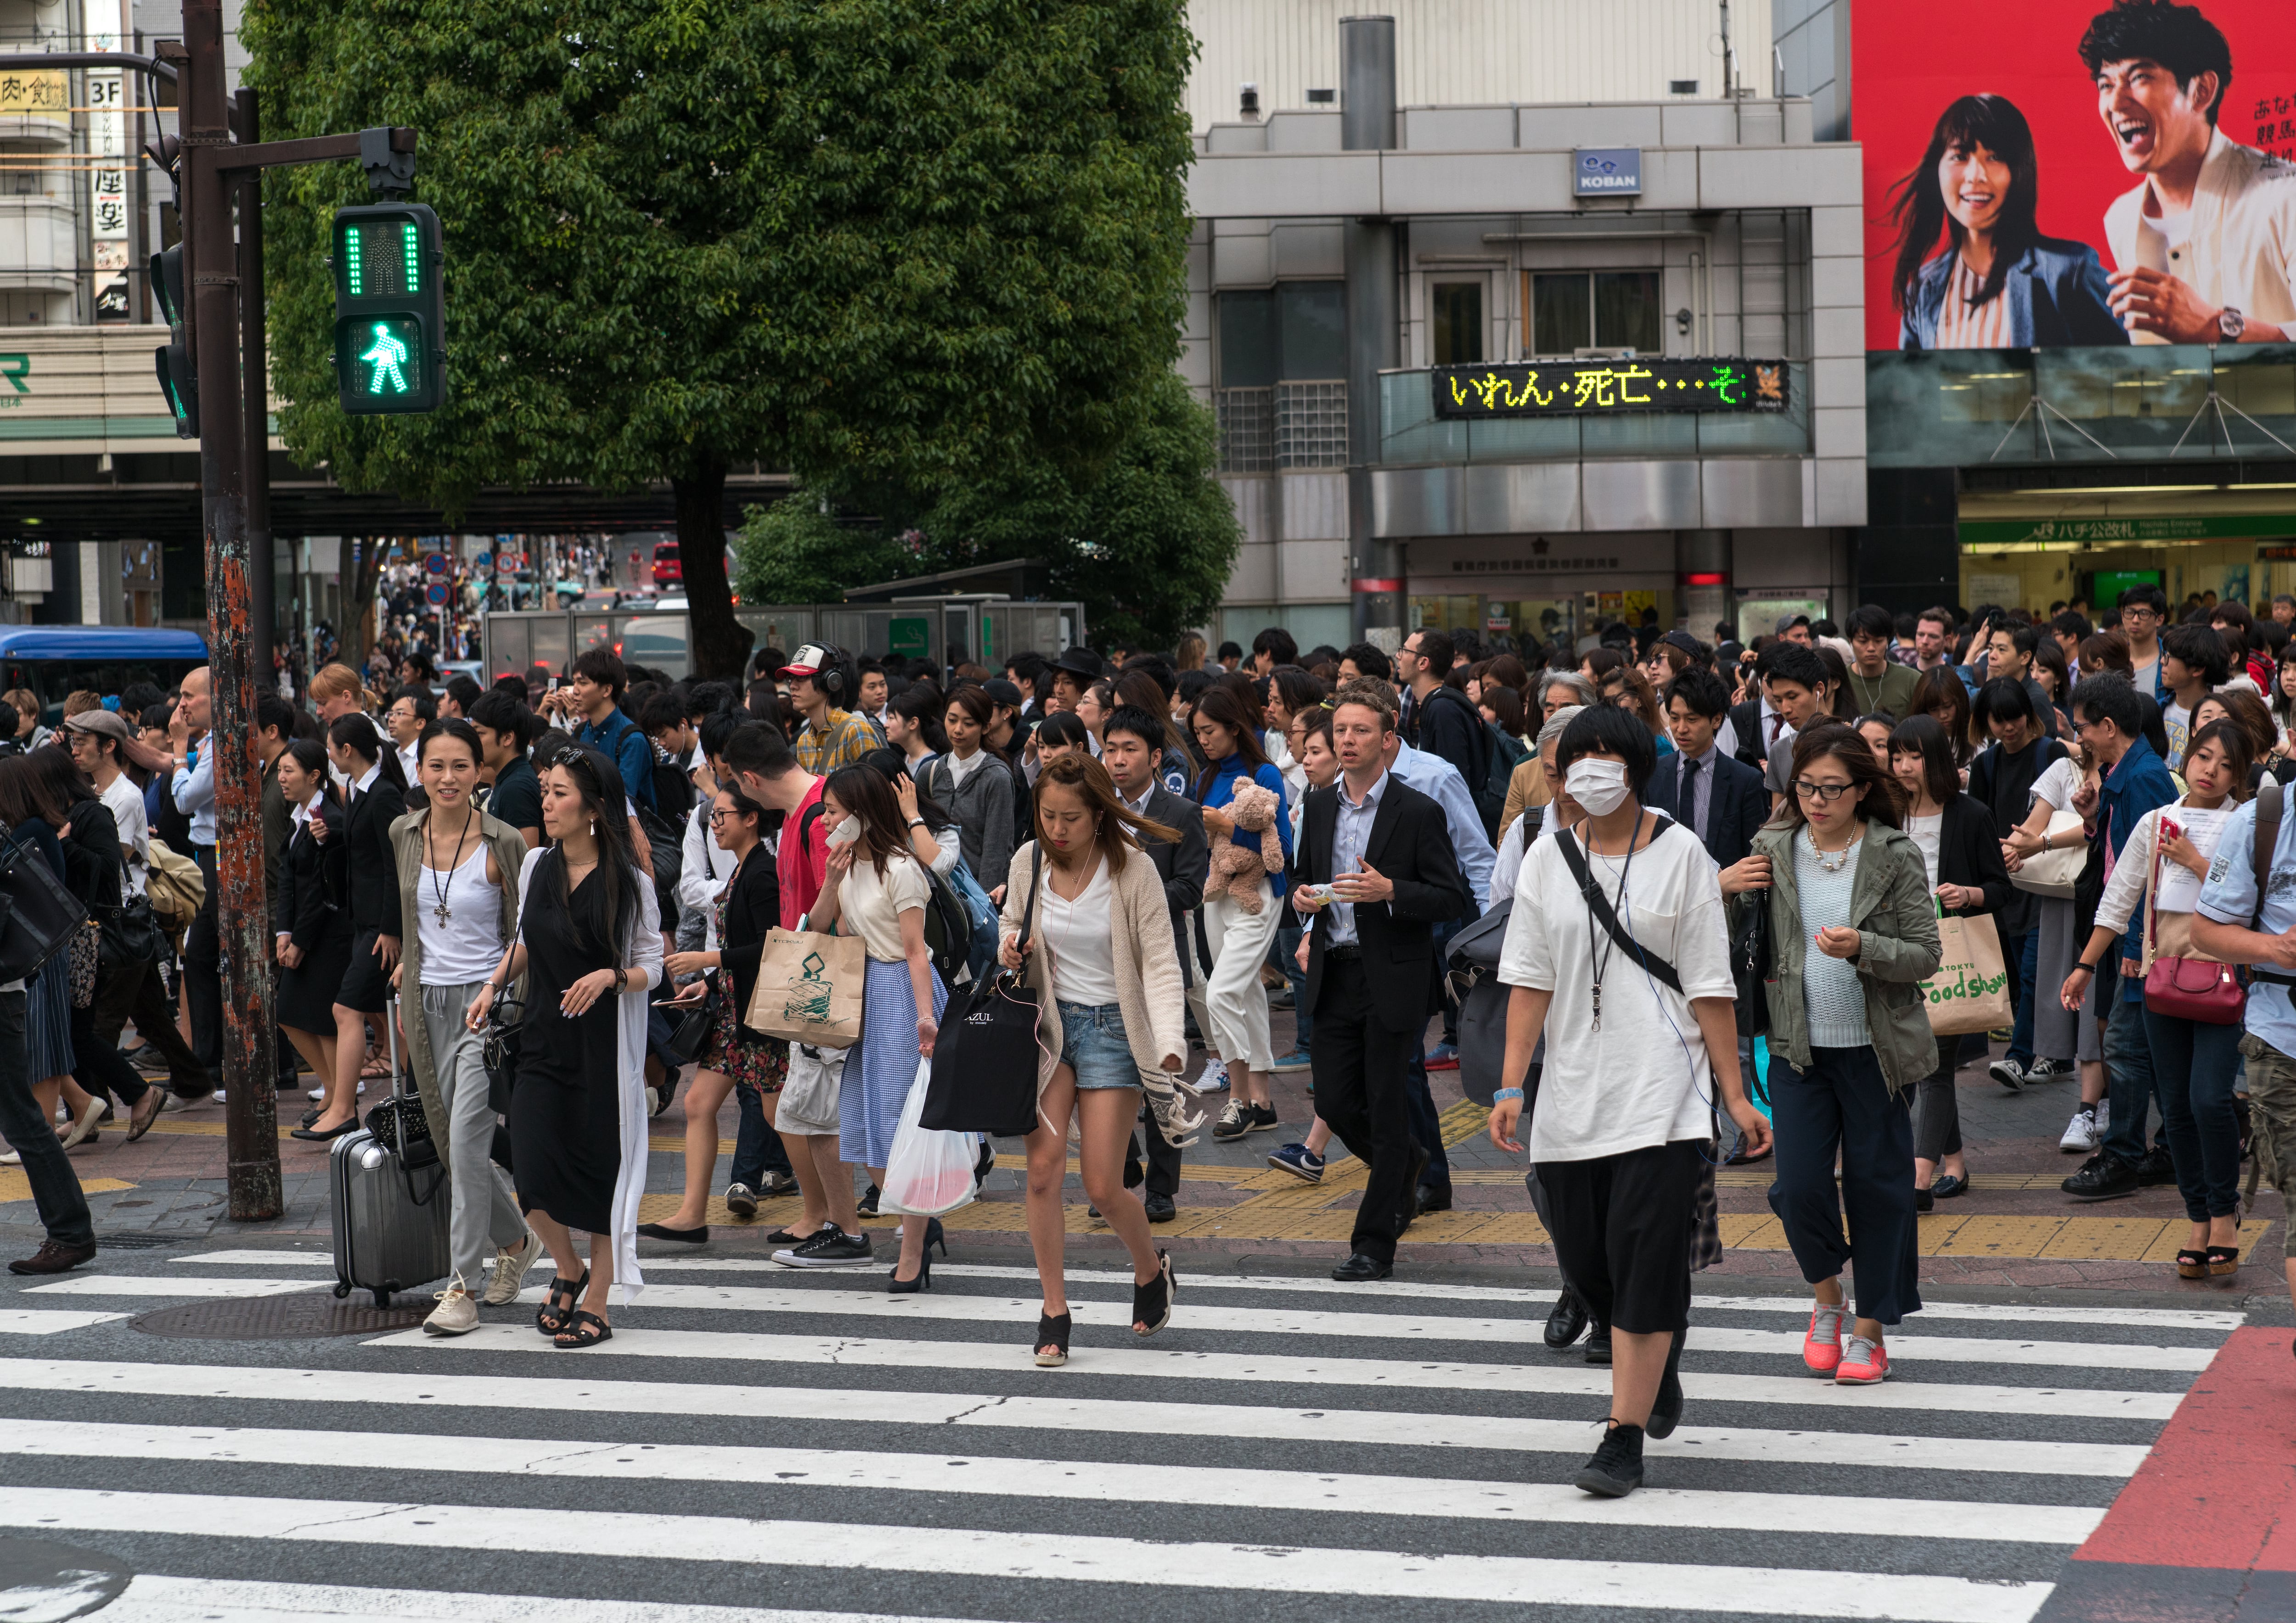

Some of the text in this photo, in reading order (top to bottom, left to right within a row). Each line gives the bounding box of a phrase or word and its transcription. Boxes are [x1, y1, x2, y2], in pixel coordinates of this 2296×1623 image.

[91, 81, 120, 104] 3F
[1581, 175, 1636, 188] KOBAN
[2059, 521, 2135, 539] ハチ公改札
[964, 1012, 994, 1021] AZUL
